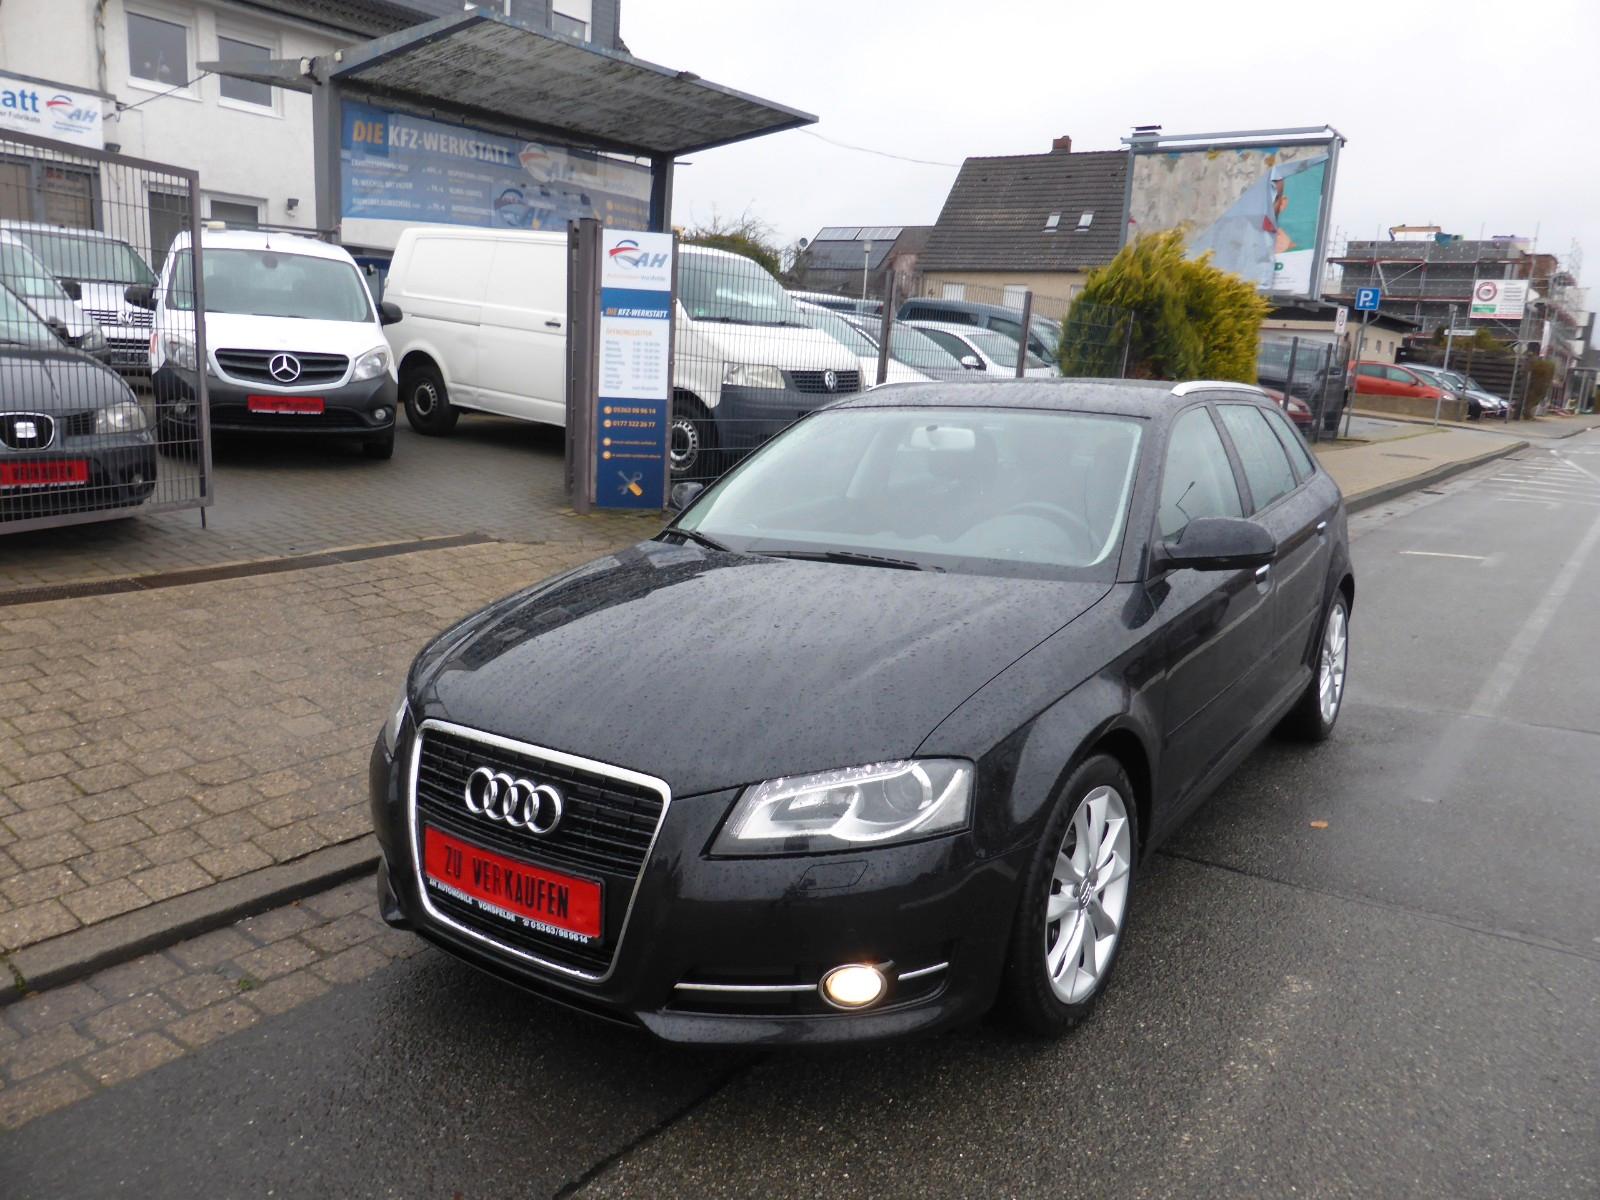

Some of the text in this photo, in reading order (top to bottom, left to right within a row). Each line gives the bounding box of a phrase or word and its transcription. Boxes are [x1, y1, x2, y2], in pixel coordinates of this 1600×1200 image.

[2, 89, 39, 113] att
[353, 120, 383, 144] DIE
[388, 125, 510, 165] KFZ-WERKSTATT
[1359, 291, 1373, 307] P
[618, 309, 668, 318] KFZ-WERKSTATT
[446, 847, 569, 918] ZU VERKAUFEN
